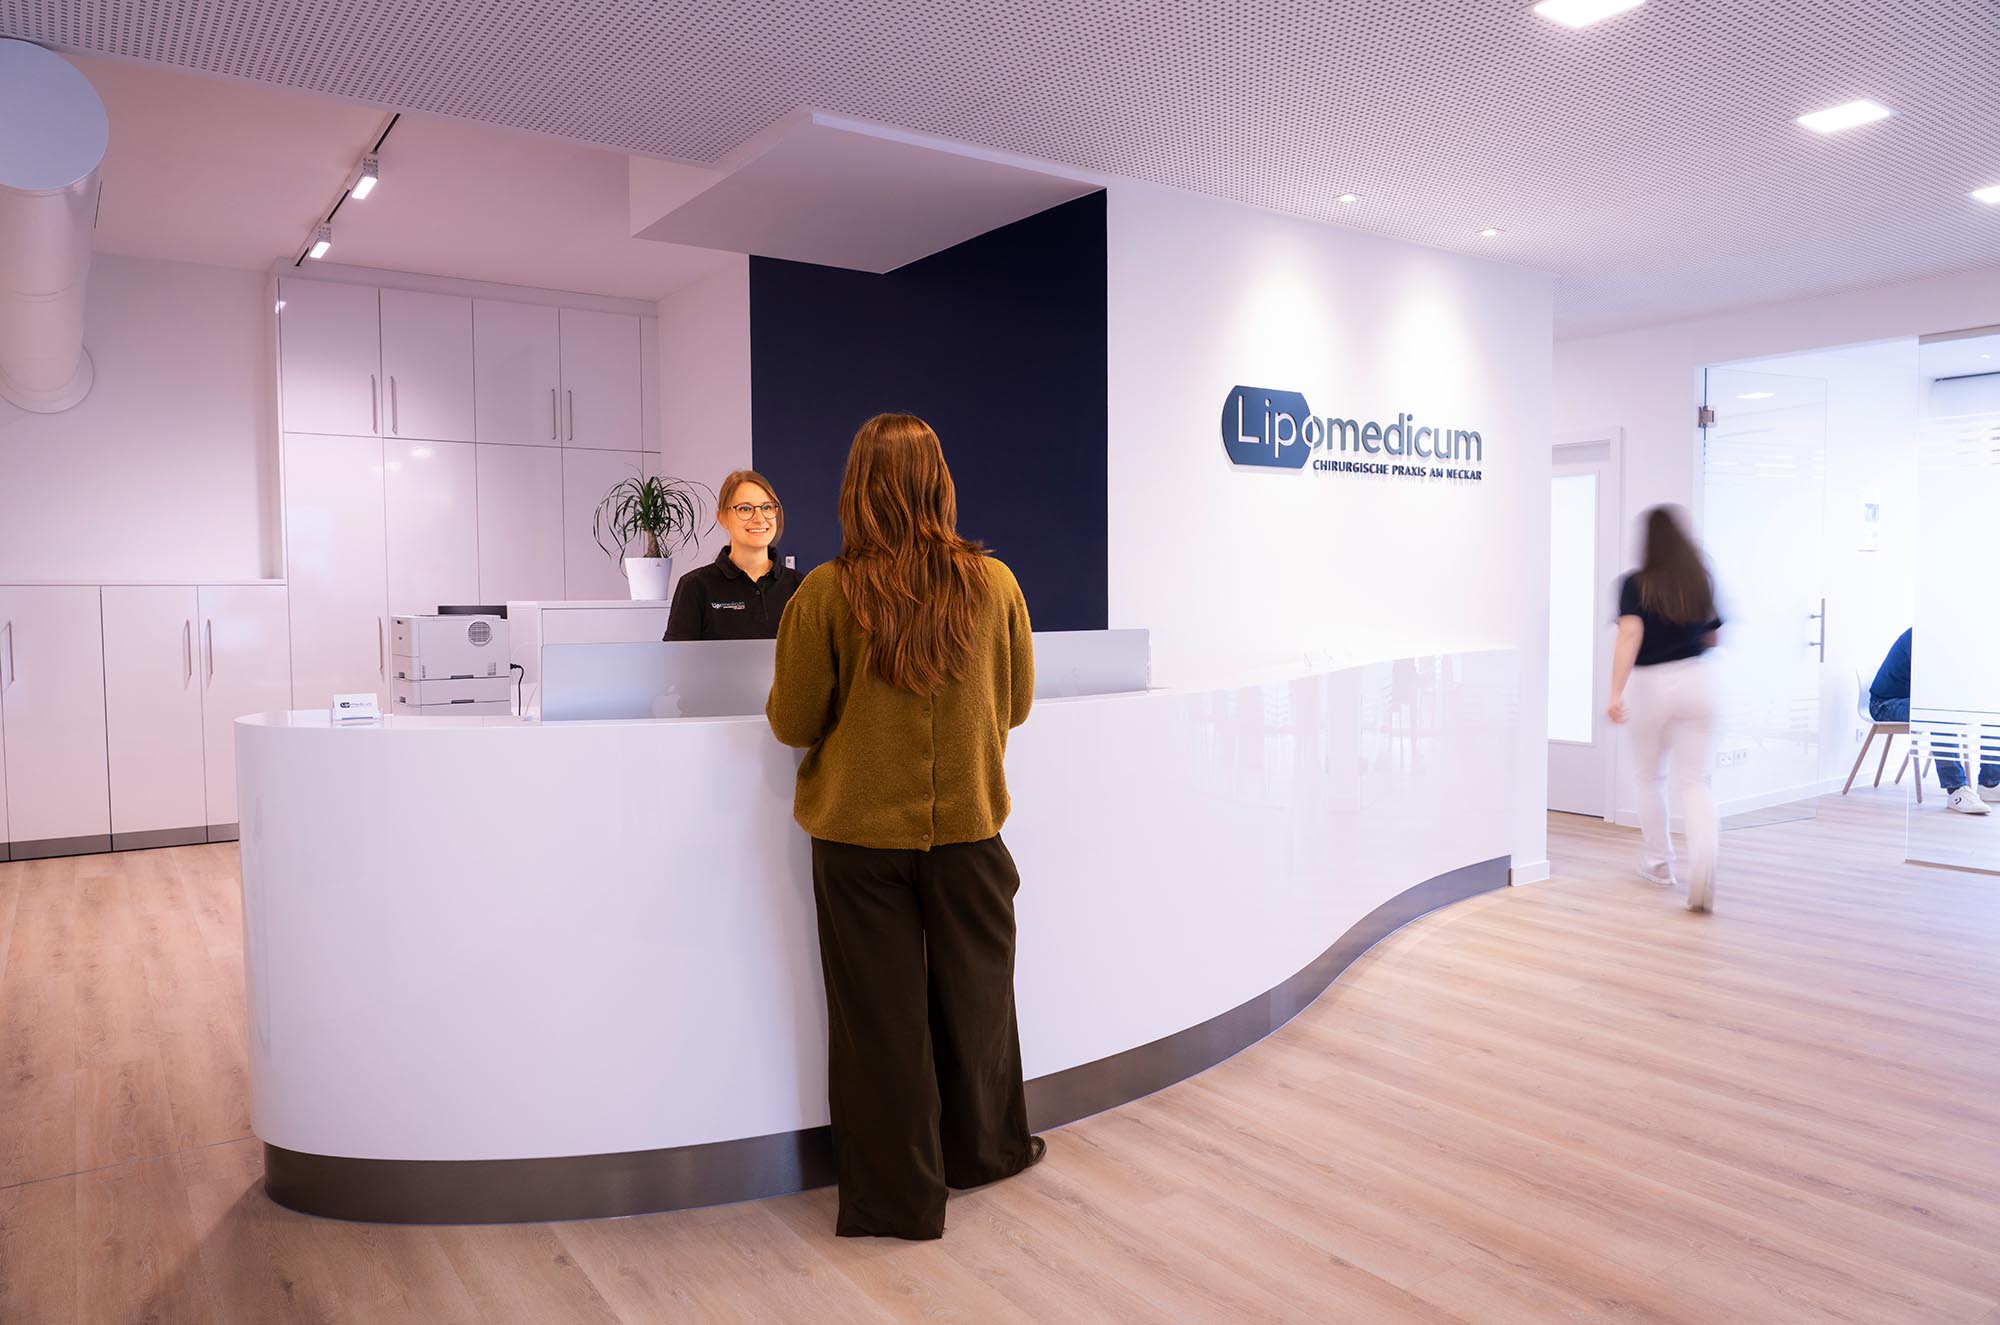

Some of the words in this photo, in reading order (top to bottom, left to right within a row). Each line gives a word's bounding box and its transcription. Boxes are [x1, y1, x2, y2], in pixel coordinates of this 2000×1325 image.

[1238, 395, 1482, 461] Lipomedicum
[1313, 460, 1389, 475] CHIRURGISCHE
[1392, 465, 1426, 478] PRAXIS
[1429, 468, 1444, 478] AM
[1446, 469, 1482, 480] NECKAR
